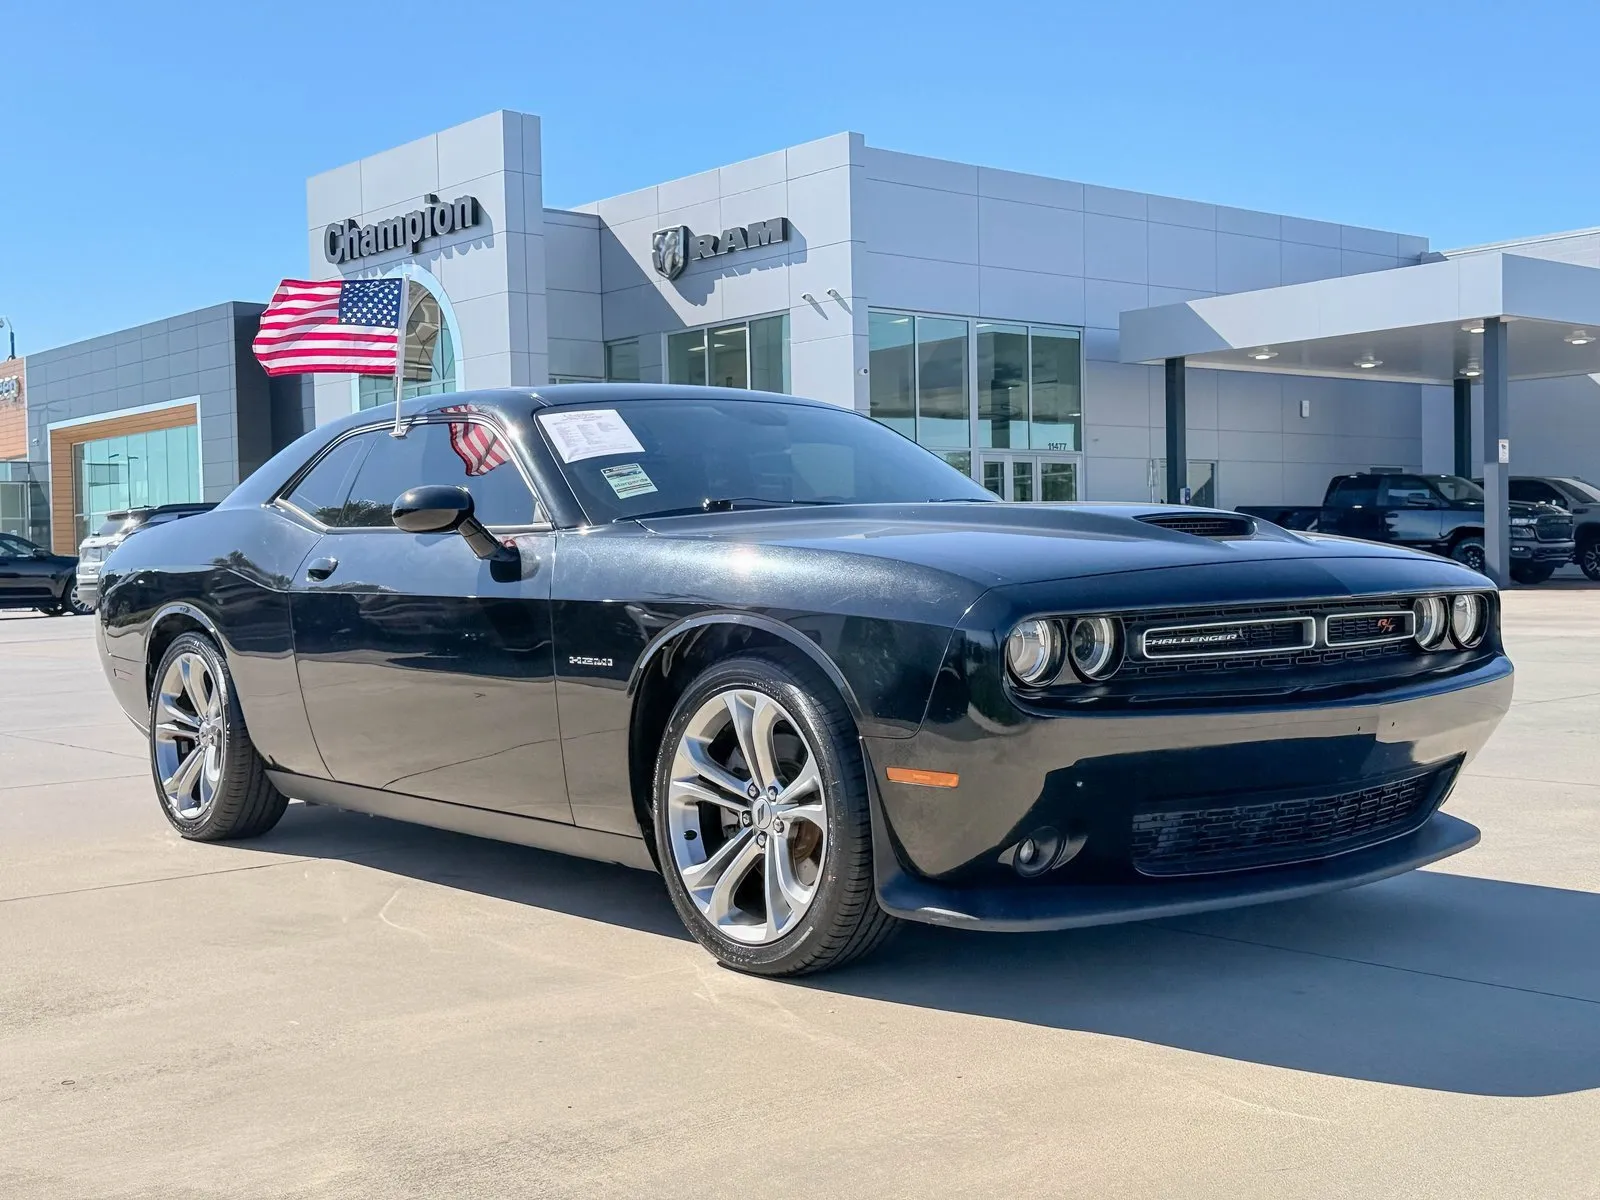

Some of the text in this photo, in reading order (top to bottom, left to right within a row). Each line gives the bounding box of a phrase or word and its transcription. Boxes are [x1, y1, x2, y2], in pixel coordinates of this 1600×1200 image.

[324, 193, 480, 264] Champion
[690, 217, 788, 261] RAM
[1047, 442, 1067, 451] 11477
[1377, 617, 1396, 633] R/T
[1145, 634, 1237, 646] CHALLENGER
[569, 656, 613, 667] HEMI
